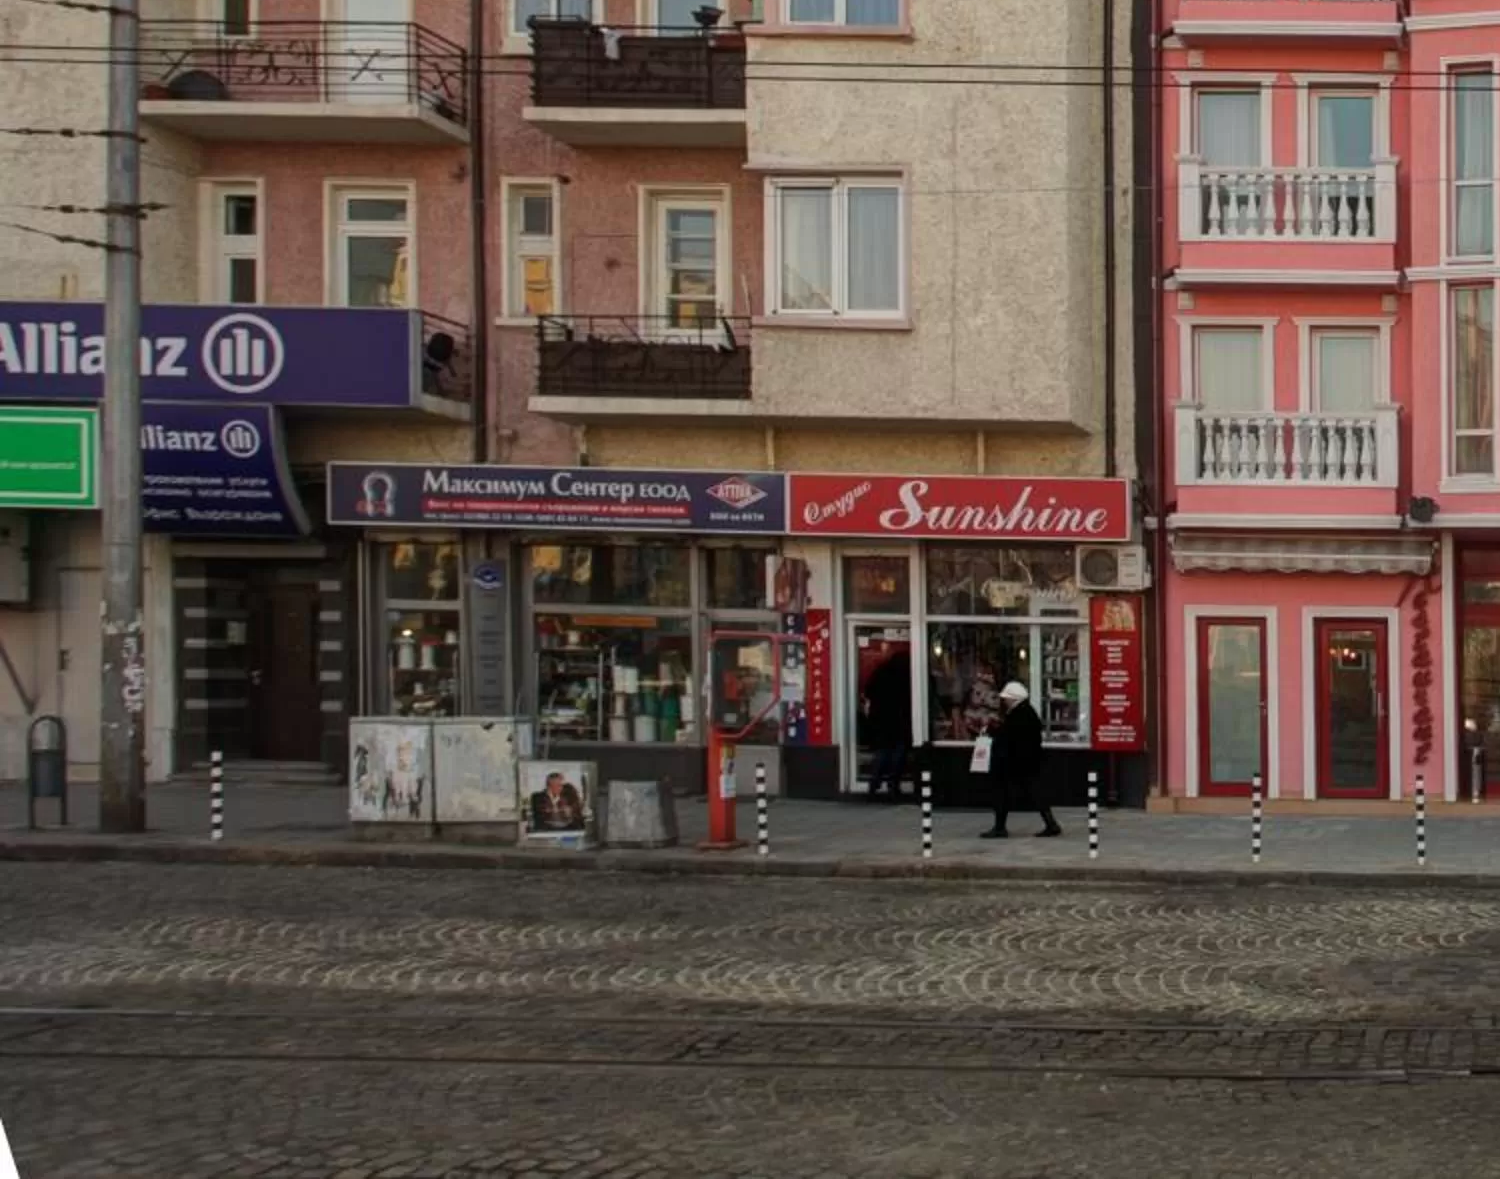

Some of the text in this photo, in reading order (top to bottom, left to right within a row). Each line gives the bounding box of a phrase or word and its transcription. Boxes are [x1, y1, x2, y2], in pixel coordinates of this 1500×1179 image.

[140, 424, 219, 452] llianz
[423, 469, 546, 501] Максимум
[550, 472, 635, 503] Сентер
[640, 483, 692, 502] ЕООД
[879, 480, 1109, 533] Sunshine
